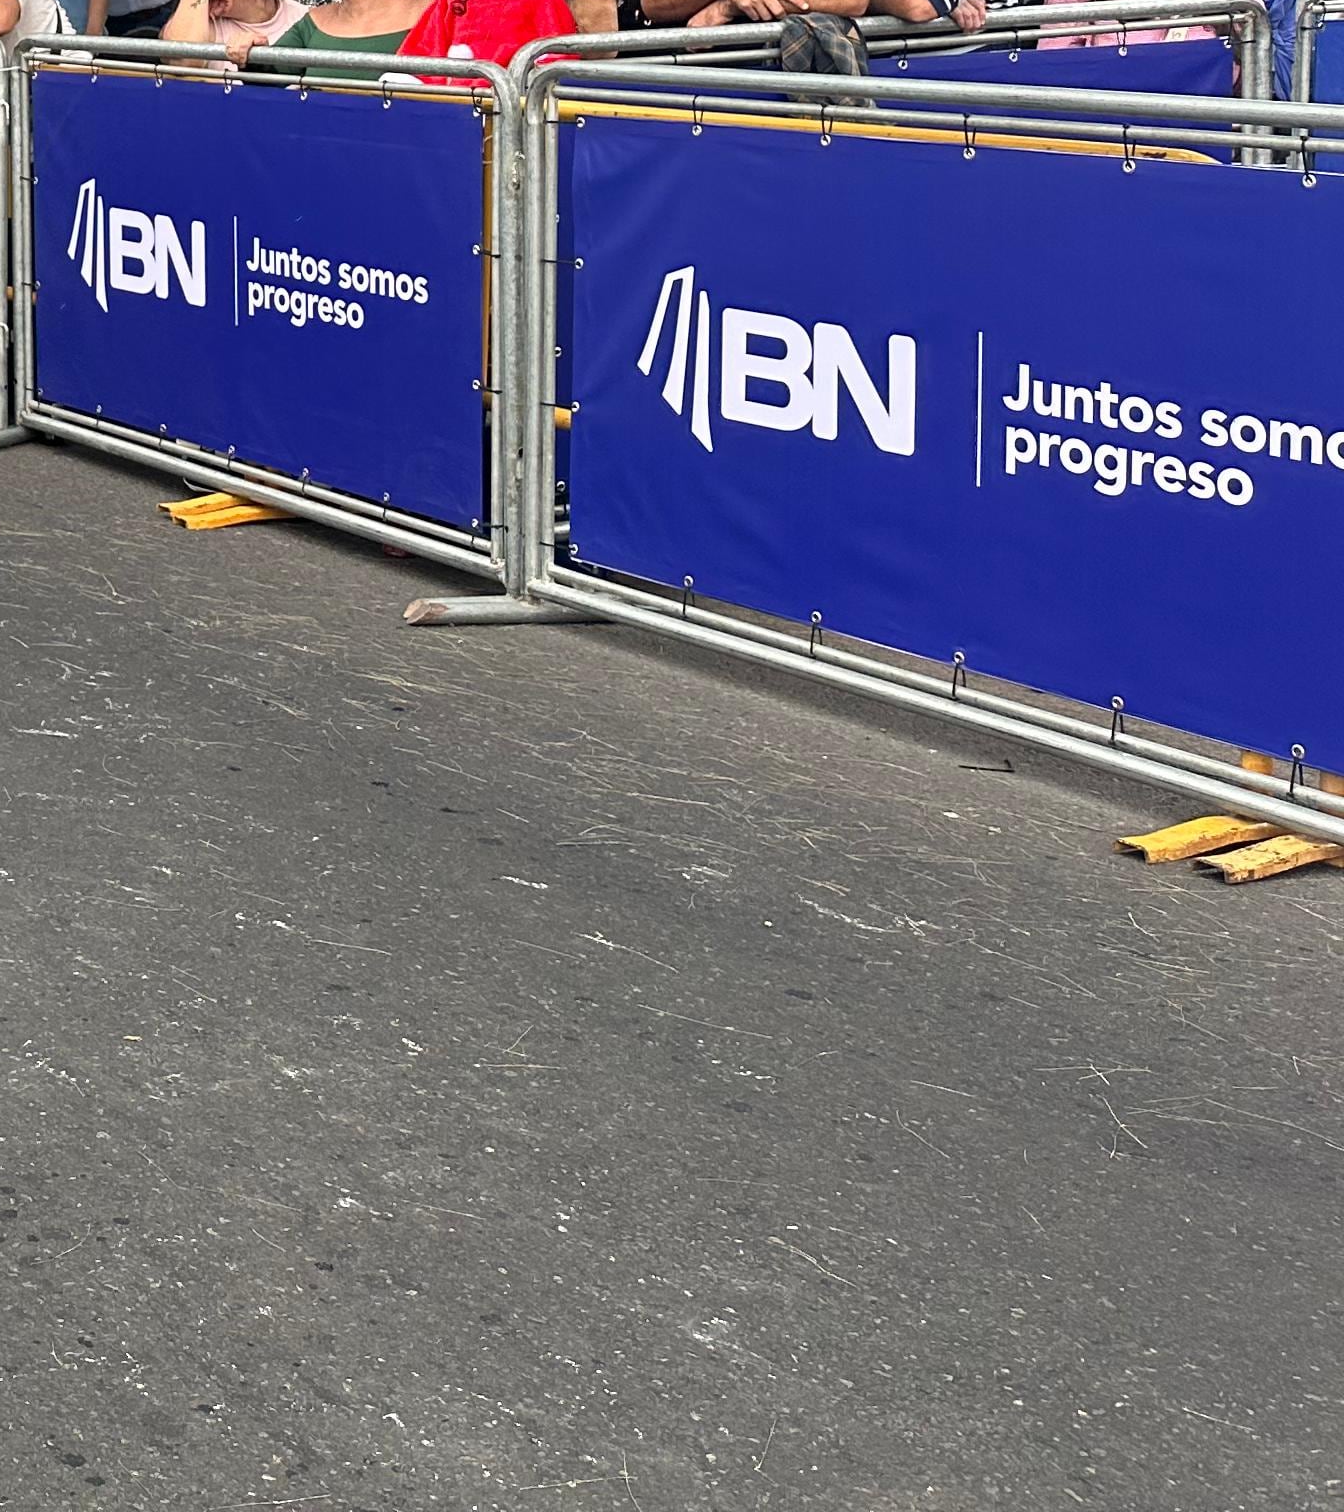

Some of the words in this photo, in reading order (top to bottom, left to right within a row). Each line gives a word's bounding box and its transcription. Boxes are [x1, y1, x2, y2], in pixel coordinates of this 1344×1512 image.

[109, 207, 206, 307] BN
[246, 237, 332, 285] Juntos
[338, 262, 429, 304] somos
[248, 281, 365, 329] progreso
[720, 307, 917, 457] BN
[1002, 363, 1183, 439] Juntos
[1005, 425, 1254, 506] progreso
